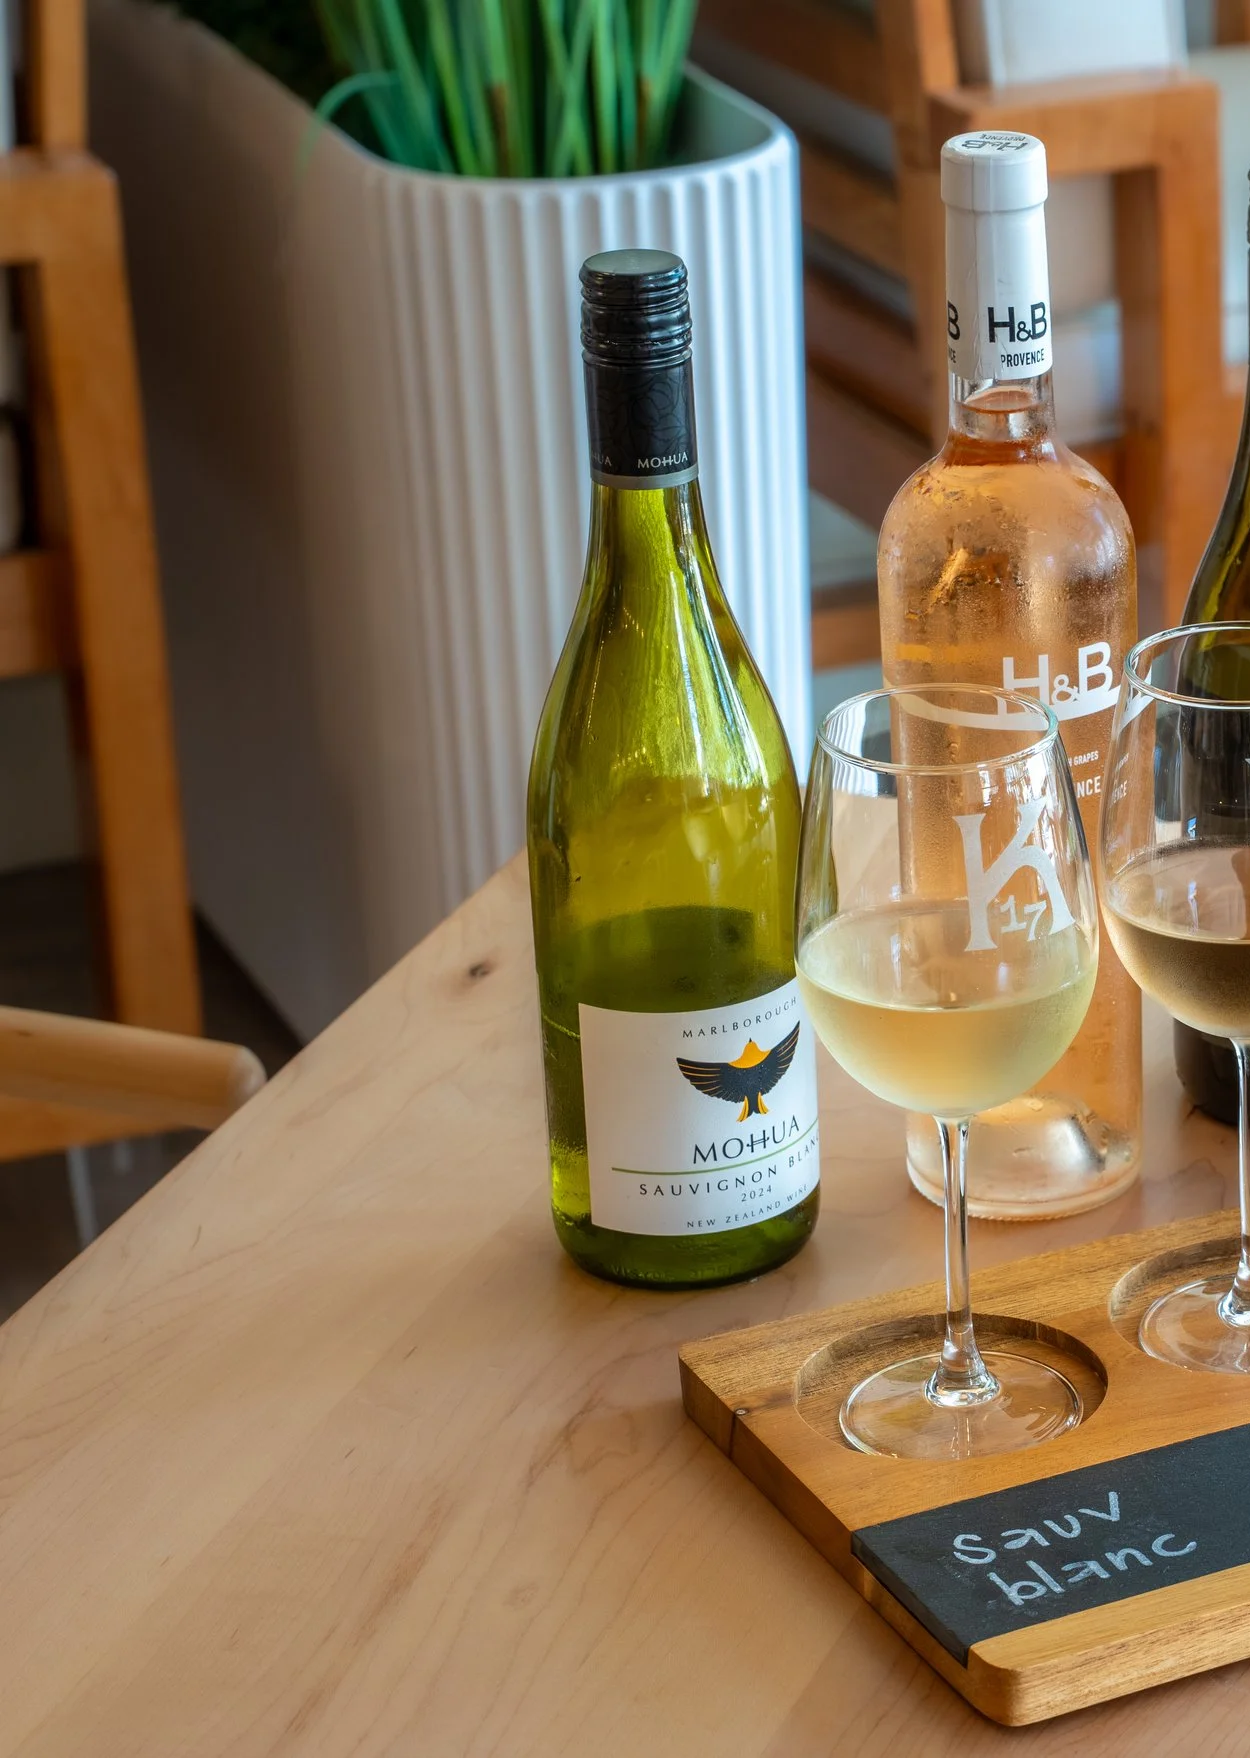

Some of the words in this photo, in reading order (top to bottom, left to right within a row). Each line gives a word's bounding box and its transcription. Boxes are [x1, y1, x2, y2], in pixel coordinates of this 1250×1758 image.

[987, 302, 1047, 343] H&B
[1000, 348, 1045, 368] PROVENCE
[637, 451, 688, 469] MOHUA
[1003, 641, 1114, 706] H&B
[1073, 751, 1099, 766] GRAPES
[1076, 775, 1102, 799] NCE
[952, 796, 1076, 951] K
[1000, 895, 1047, 942] 17
[682, 996, 797, 1039] MARLBOROUGH
[693, 1114, 800, 1164] MOHUA
[639, 1164, 778, 1196] SAUVIGNON
[742, 1185, 772, 1202] 2024
[687, 1218, 716, 1228] NEW
[725, 1200, 781, 1223] ZEALAND
[786, 1184, 808, 1202] WINE
[988, 1532, 1197, 1606] blanc
